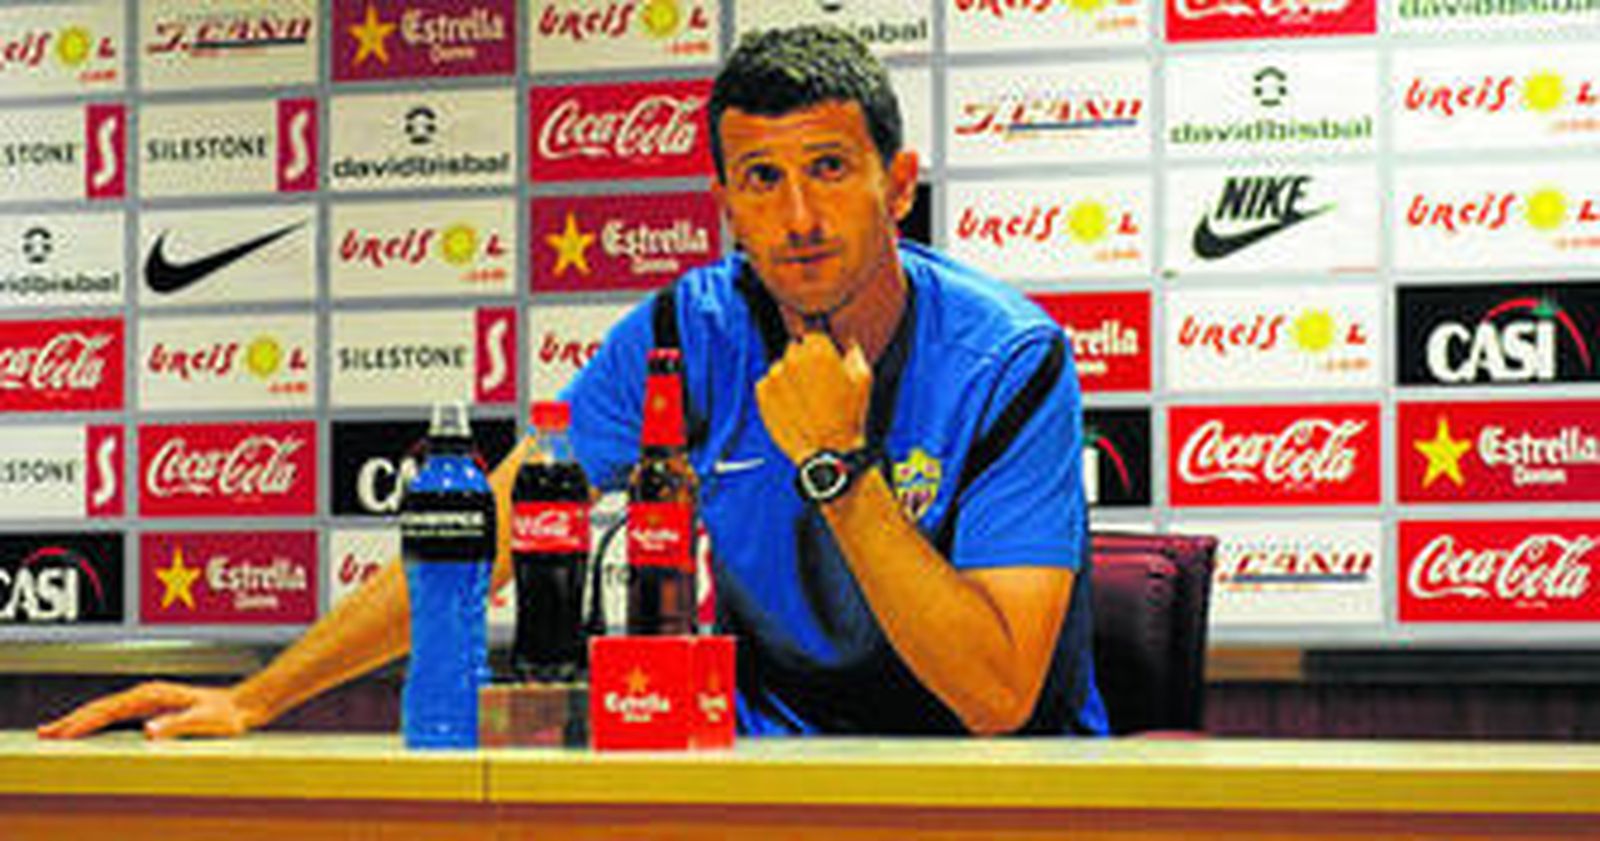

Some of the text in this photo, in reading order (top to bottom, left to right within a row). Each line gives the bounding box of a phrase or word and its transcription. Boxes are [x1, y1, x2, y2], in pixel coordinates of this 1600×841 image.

[402, 10, 504, 46] Estrella
[1170, 115, 1373, 144] davidbisbal
[146, 136, 266, 162] SILESTONE
[333, 152, 510, 179] davidbisbal
[1215, 174, 1313, 222] NIKE
[602, 219, 709, 258] Estrella
[338, 346, 466, 371] SILESTONE
[1426, 320, 1557, 382] CASI
[1478, 426, 1600, 466] Estrella
[206, 557, 307, 591] Estrella
